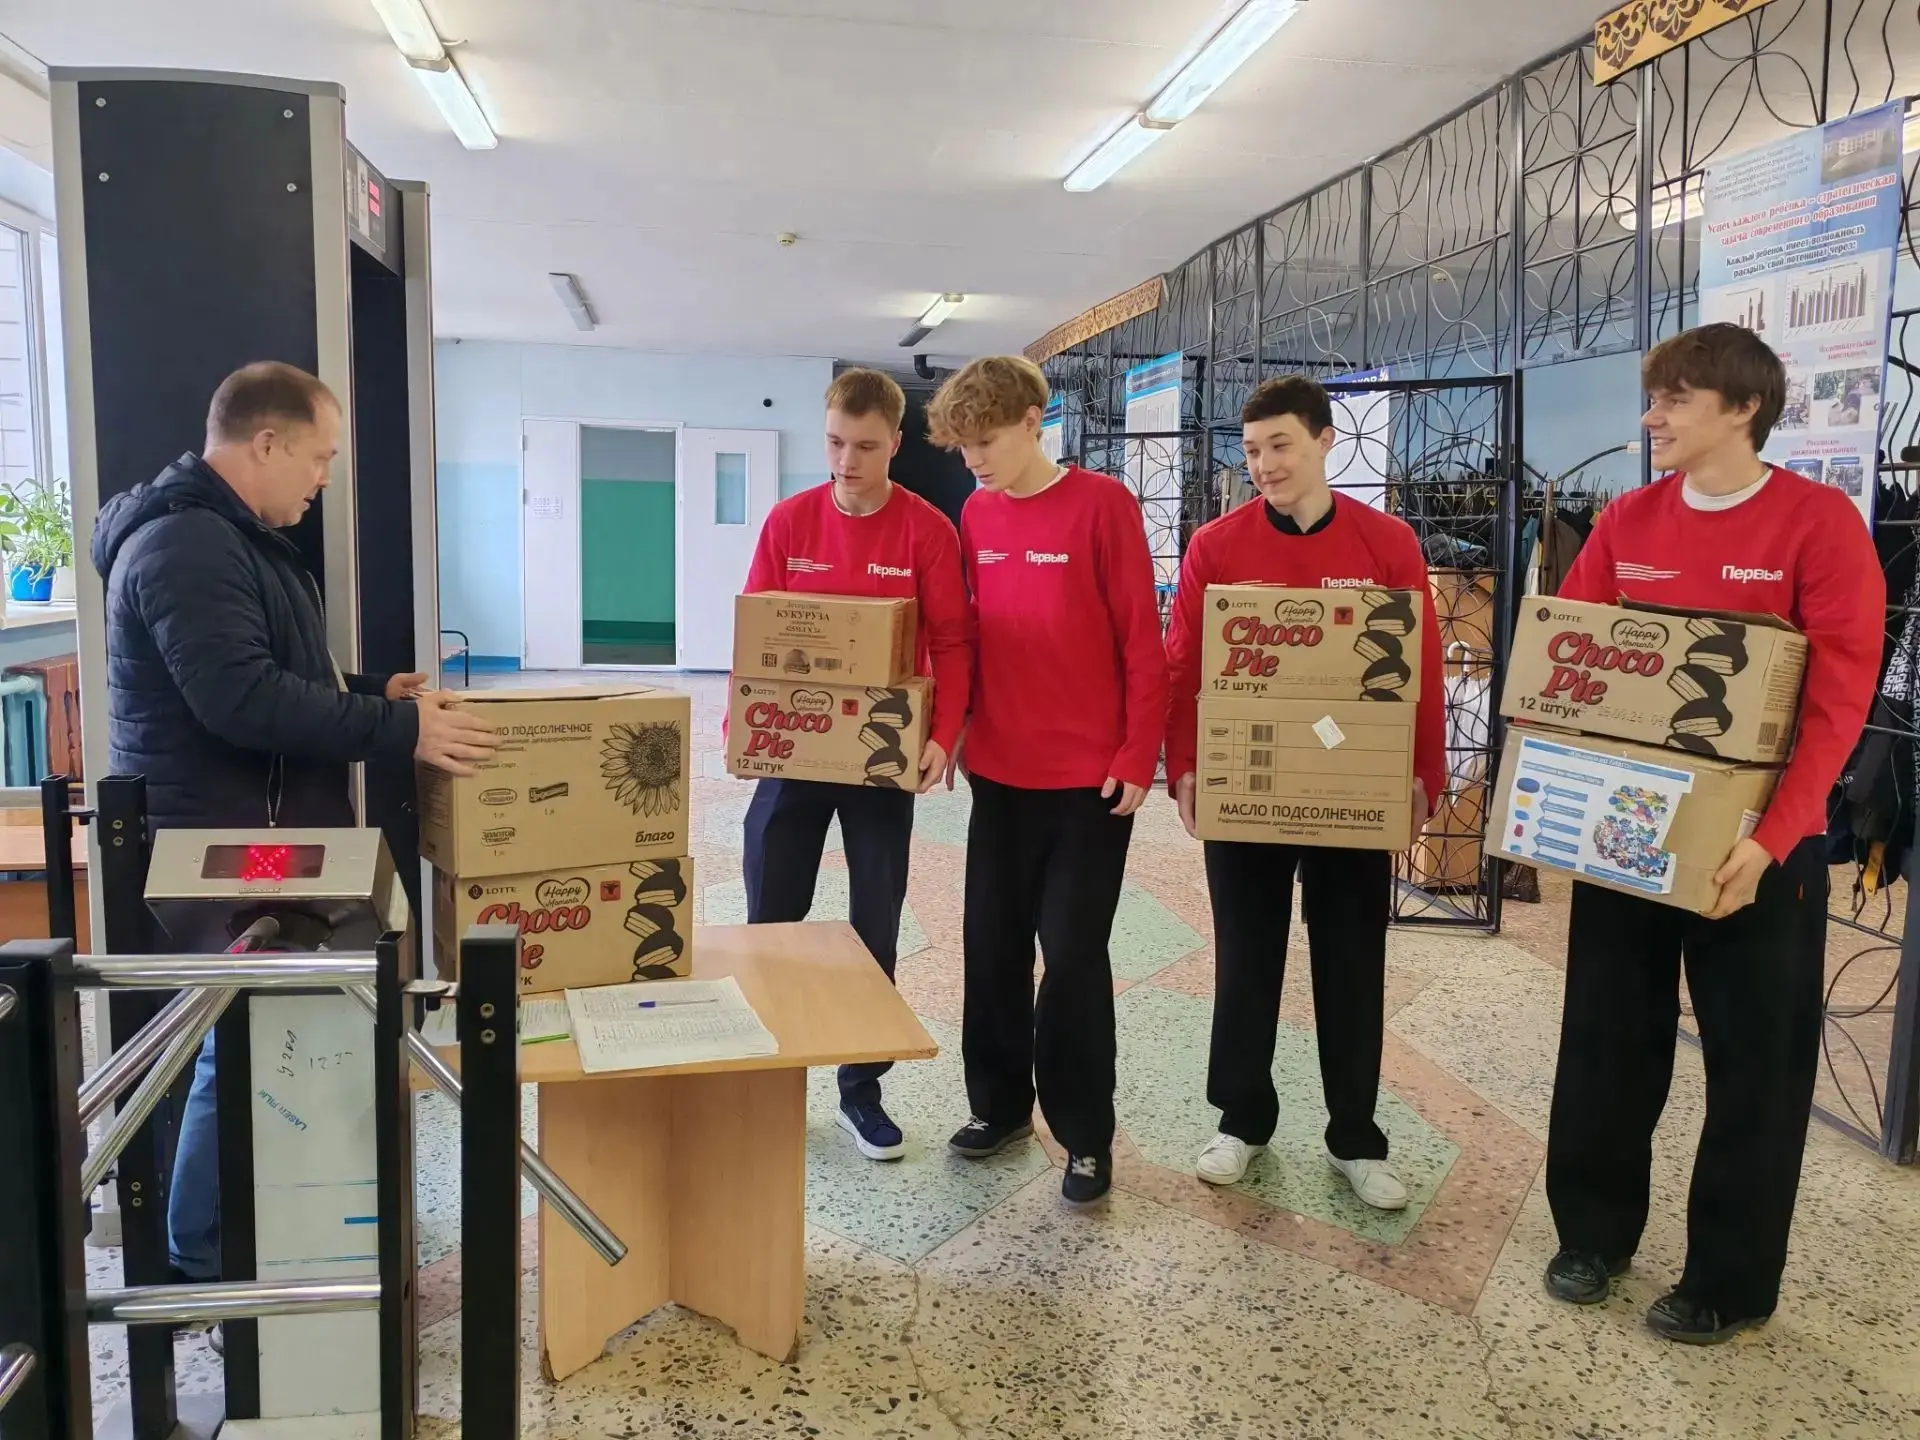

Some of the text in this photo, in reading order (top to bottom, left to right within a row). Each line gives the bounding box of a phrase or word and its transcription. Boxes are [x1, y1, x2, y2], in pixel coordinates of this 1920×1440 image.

[1026, 550, 1069, 566] Первые
[867, 563, 912, 578] Первые
[1722, 565, 1784, 583] Первые
[1321, 577, 1374, 589] Первые
[1231, 601, 1258, 609] LOTTE
[1282, 605, 1318, 619] Happy
[776, 609, 830, 621] КУКУРУЗА
[1552, 611, 1584, 624] LOTTE
[1222, 616, 1324, 647] Choco
[1618, 624, 1660, 642] Happy
[1220, 647, 1280, 677] Pie
[1547, 630, 1665, 678] Choco
[1212, 679, 1268, 694] 12 штук
[1539, 665, 1608, 706] Pie
[797, 694, 828, 706] Happy
[1518, 696, 1581, 720] 12 штук
[744, 701, 833, 734] Choco
[512, 723, 593, 737] ПОДСОЛНЕЧНОЕ
[743, 729, 795, 759] Pie
[736, 758, 750, 769] 12
[753, 762, 785, 774] штук
[1219, 802, 1386, 823] МАСЛО ПОДСОЛНЕЧНОЕ
[486, 886, 517, 895] LOTTE
[543, 886, 583, 898] Happy
